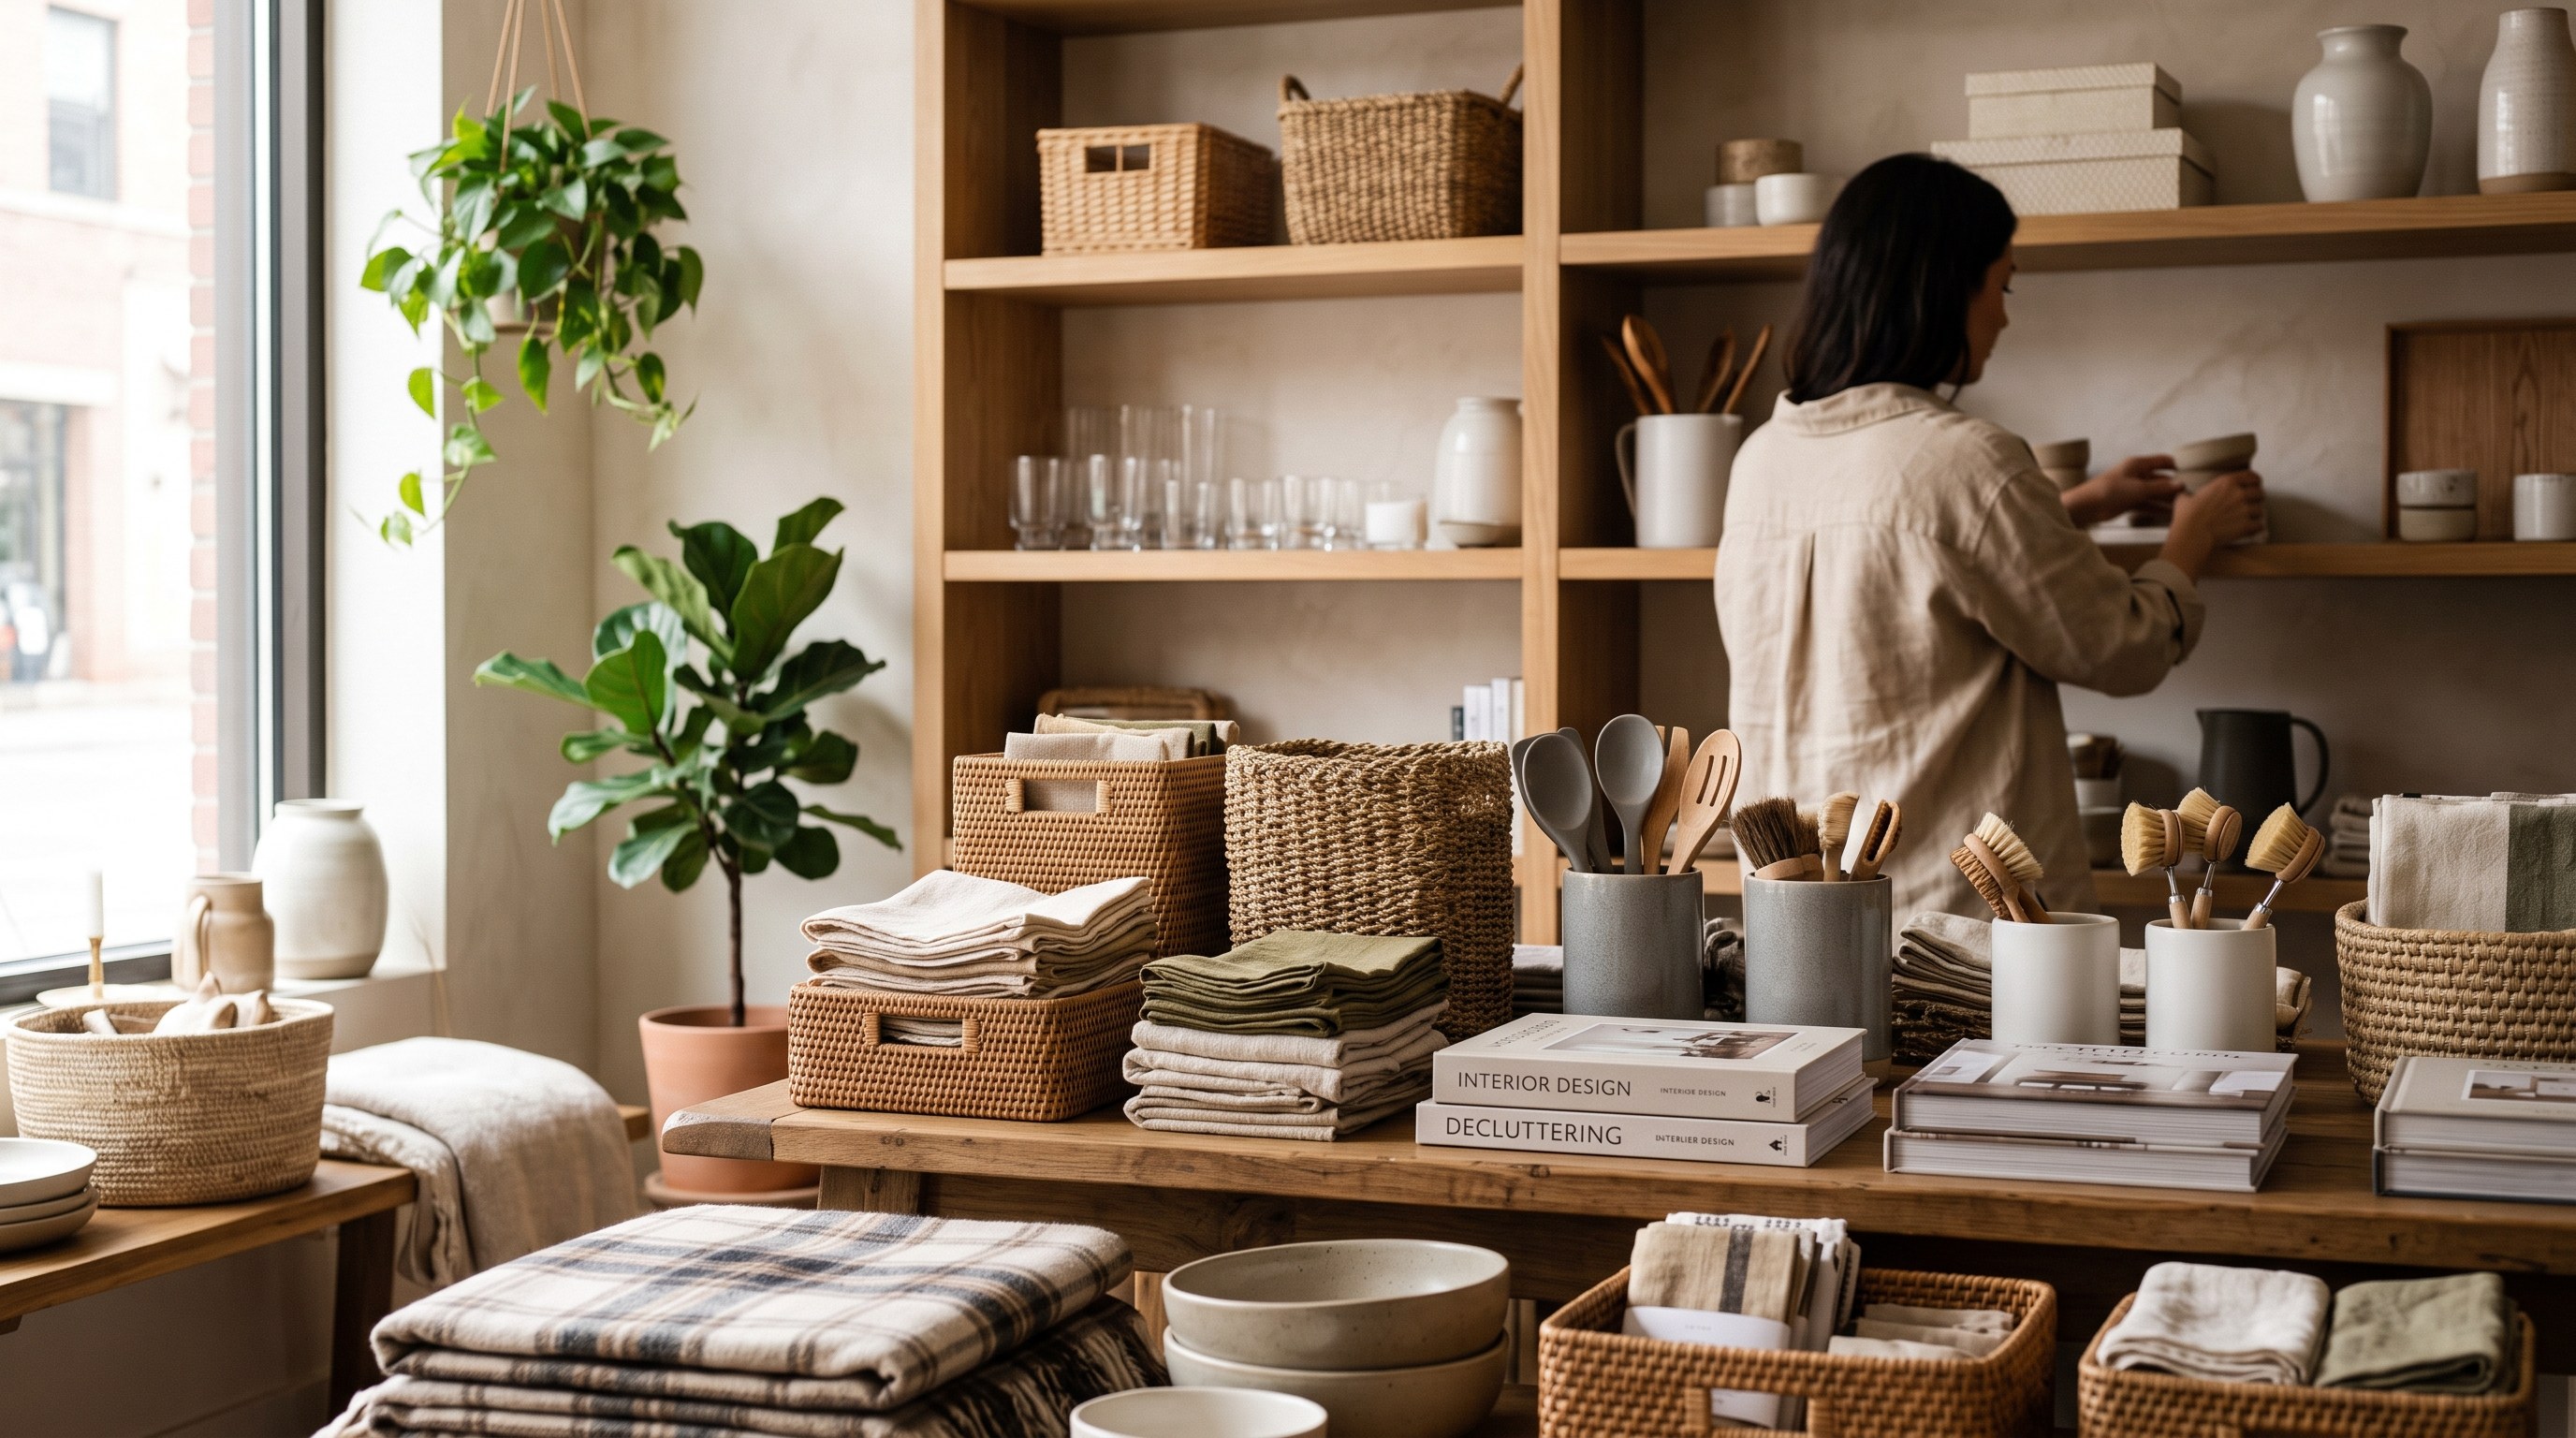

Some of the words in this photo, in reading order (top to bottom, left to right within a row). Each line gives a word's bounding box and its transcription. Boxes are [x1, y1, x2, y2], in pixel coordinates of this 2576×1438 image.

[1458, 1072, 1550, 1093] INTERIOR
[1558, 1078, 1631, 1096] DESIGN
[1446, 1117, 1622, 1145] DECLUTTERING
[1701, 1137, 1734, 1146] DESIGN
